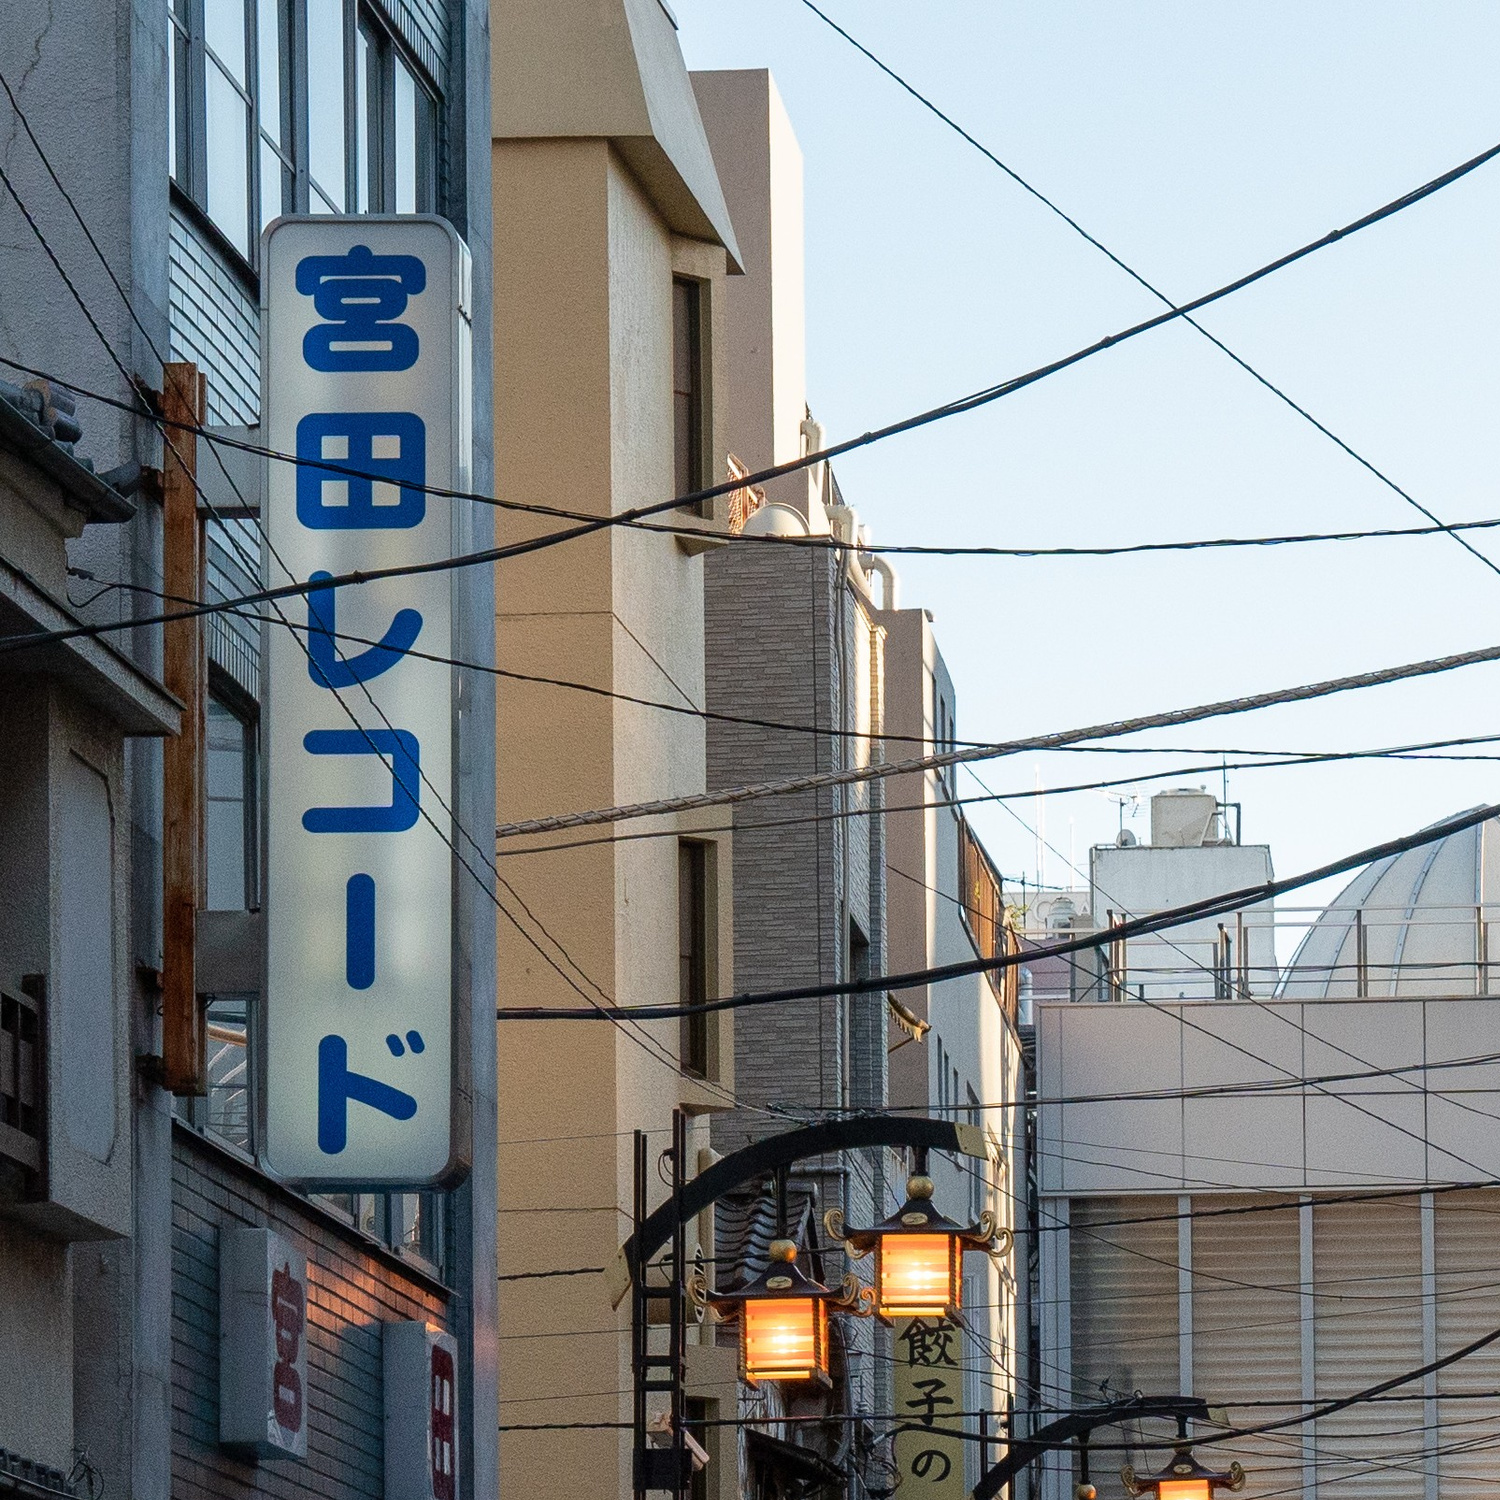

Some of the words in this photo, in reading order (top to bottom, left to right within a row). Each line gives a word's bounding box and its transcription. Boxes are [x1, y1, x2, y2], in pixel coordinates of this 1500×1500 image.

[295, 245, 426, 1155] 宮田レコード
[271, 1261, 304, 1434] 宮
